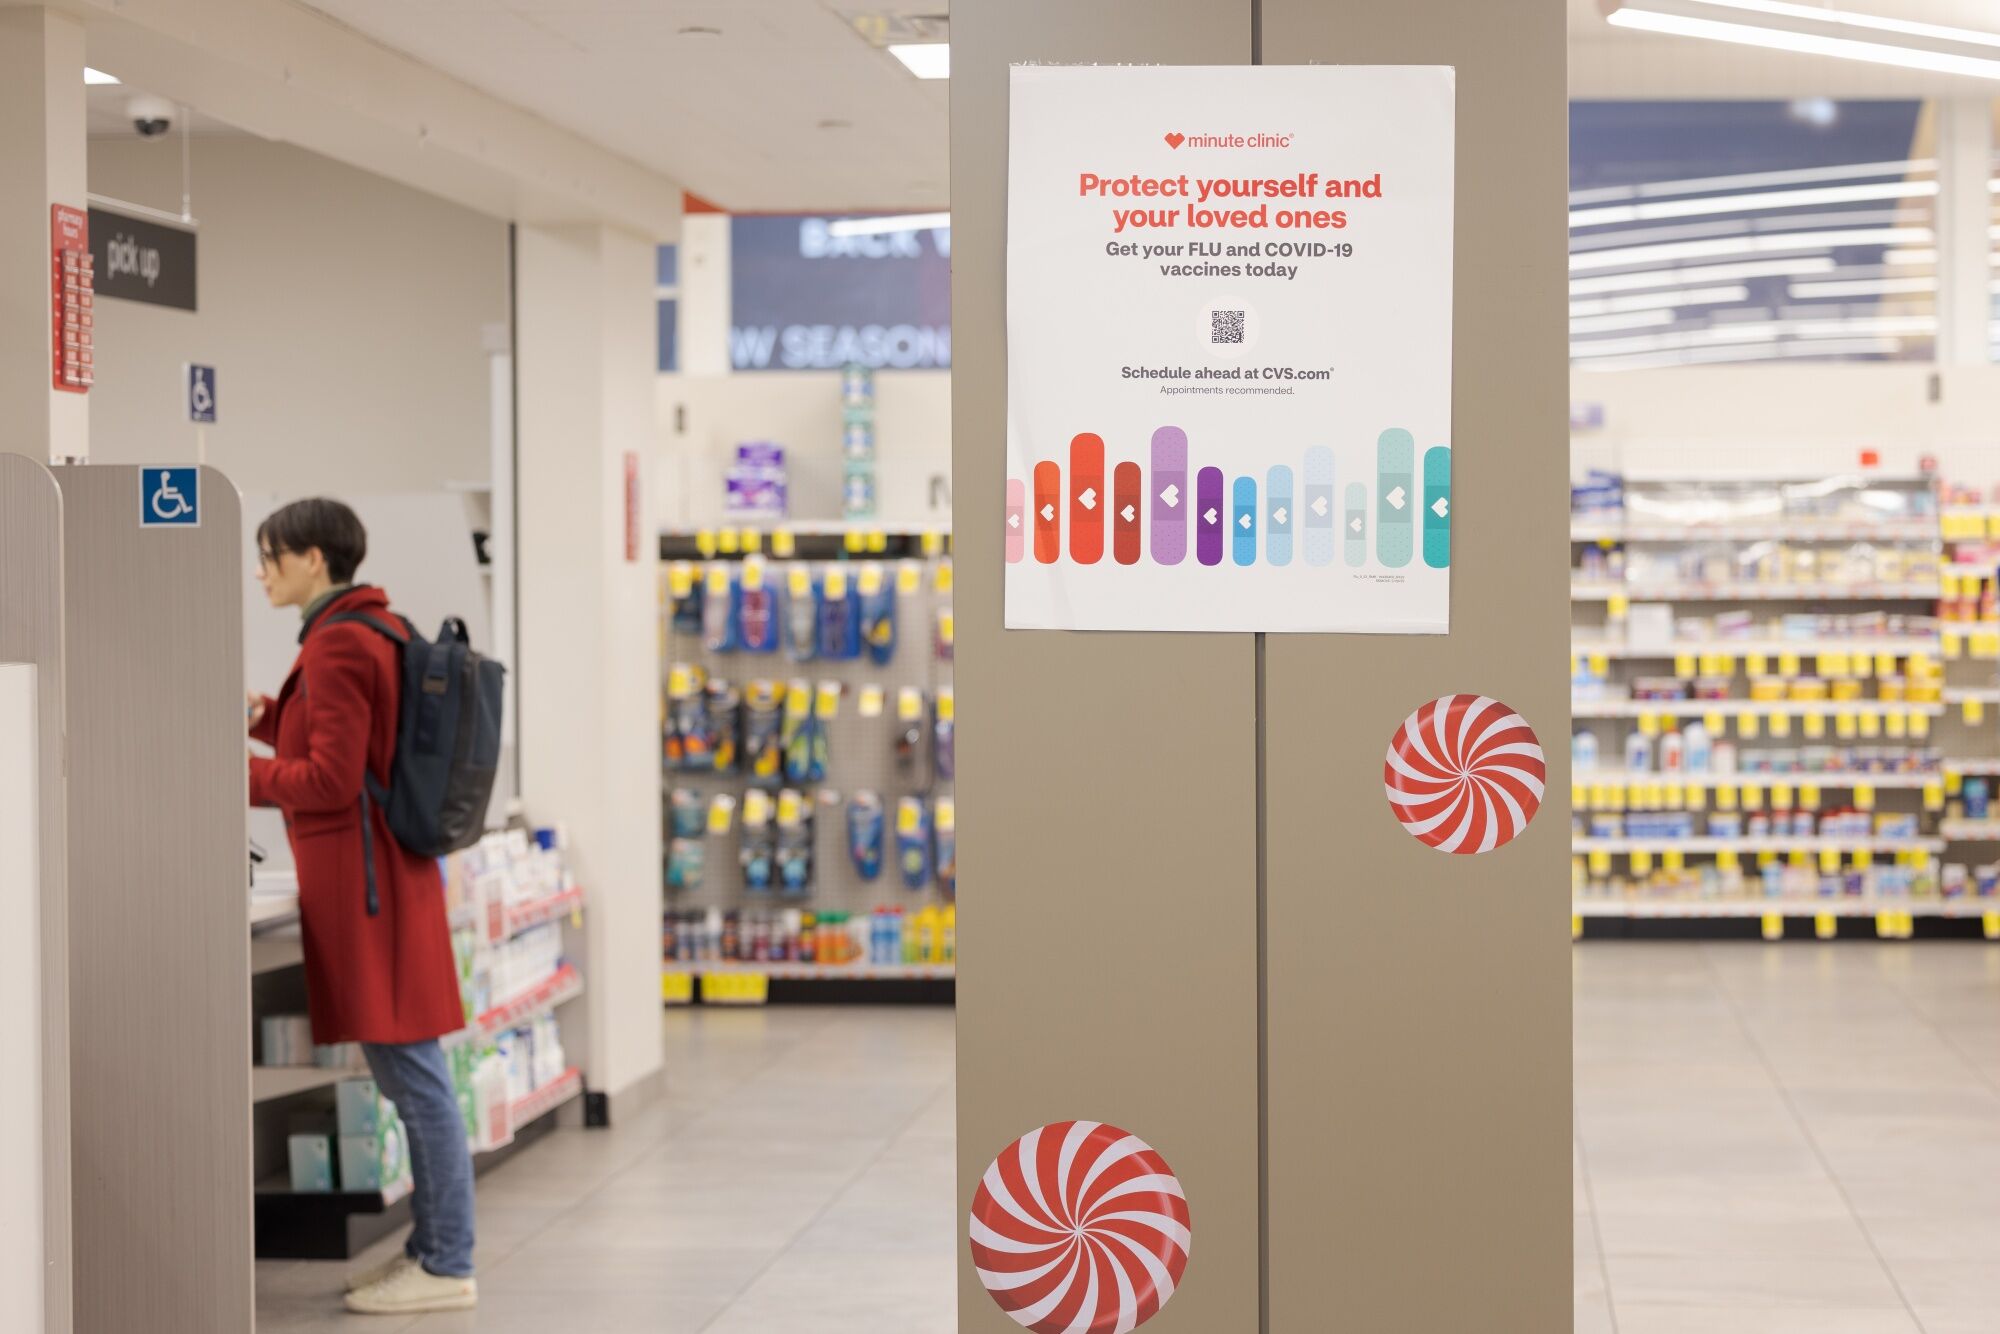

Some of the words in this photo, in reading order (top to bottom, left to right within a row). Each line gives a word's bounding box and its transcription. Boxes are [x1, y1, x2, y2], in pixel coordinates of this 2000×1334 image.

[1188, 132, 1245, 148] minute
[1079, 173, 1189, 198] Protect
[1195, 172, 1319, 203] yourself
[1324, 173, 1383, 199] and
[1112, 209, 1181, 234] your
[1187, 203, 1269, 229] loved
[1274, 210, 1348, 230] ones
[1105, 240, 1139, 257] Get
[1141, 244, 1185, 260] your
[1188, 241, 1222, 257] FLU
[1225, 241, 1261, 258] and
[1264, 241, 1353, 258] COVID-19
[107, 233, 139, 279] pick
[140, 246, 160, 288] up
[1159, 260, 1242, 277] vaccines
[1244, 261, 1299, 280] today
[1121, 365, 1192, 380] Schedule
[1194, 366, 1242, 380] ahead
[1243, 367, 1260, 380] at
[1159, 385, 1224, 396] Appointments
[1225, 385, 1295, 396] recommended.
